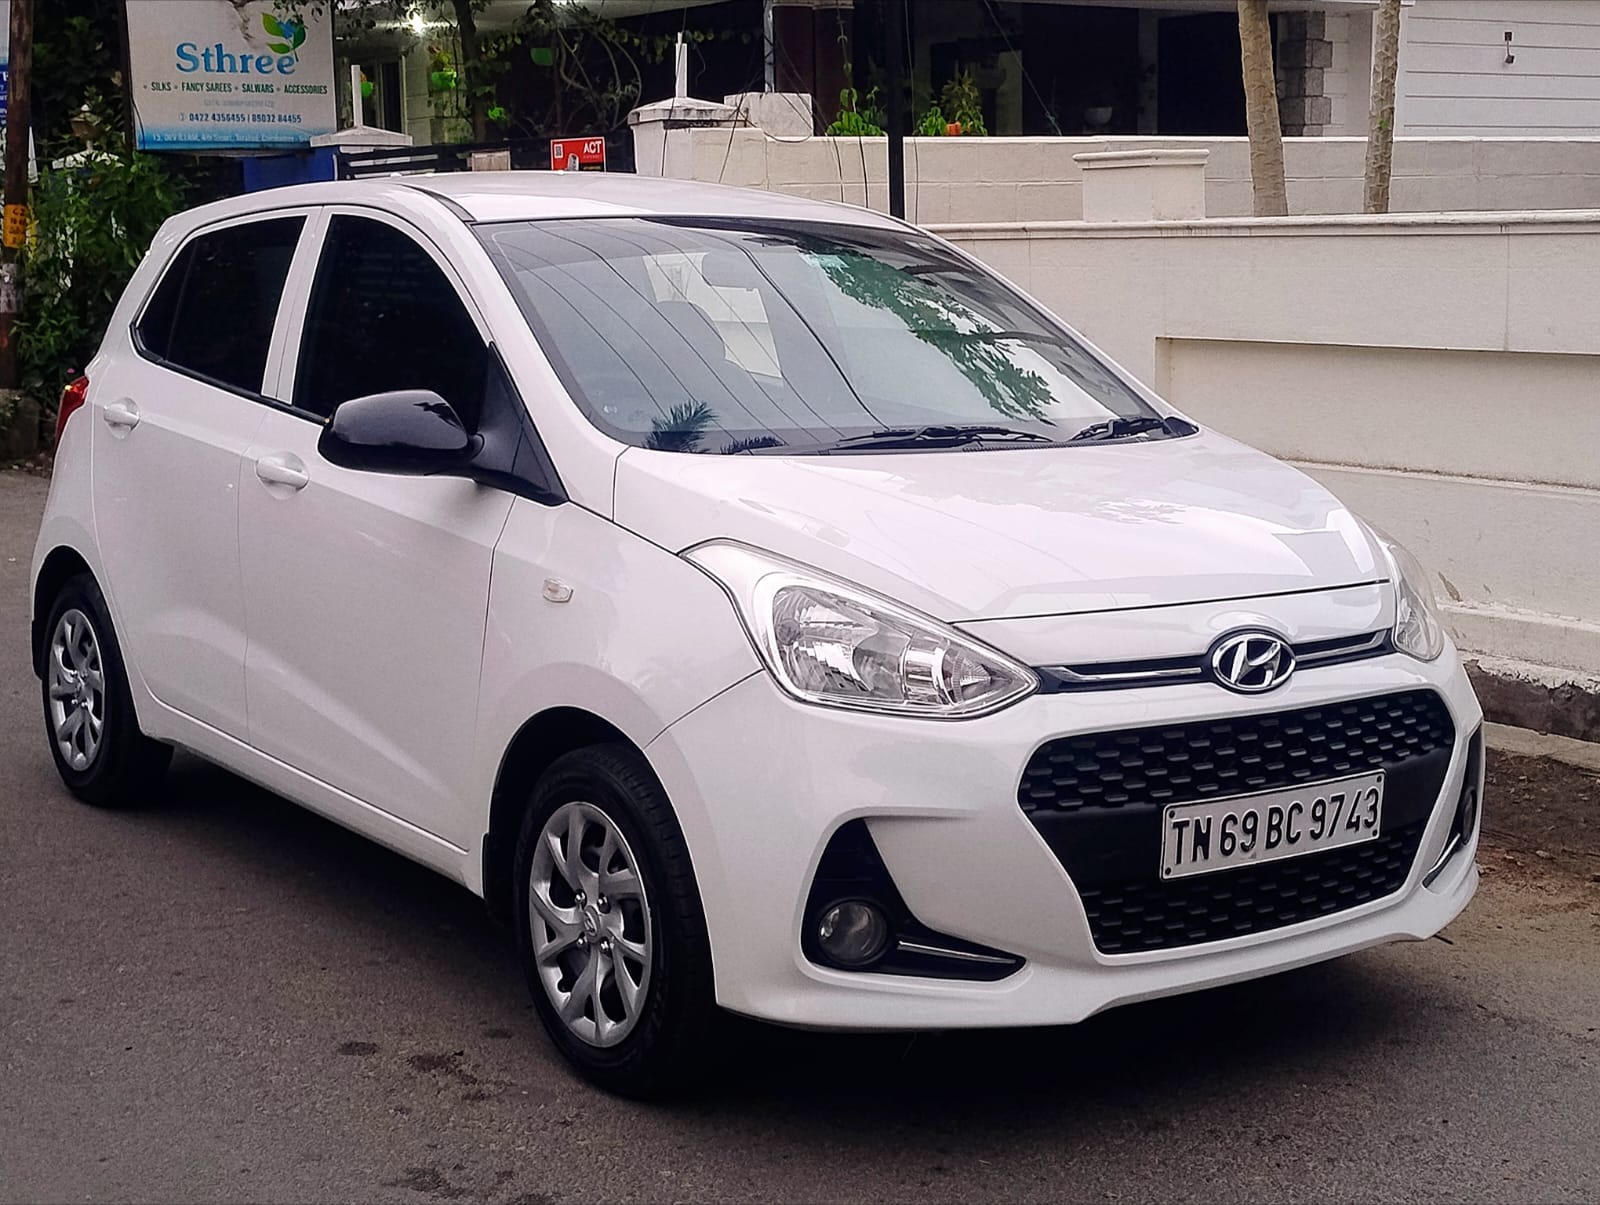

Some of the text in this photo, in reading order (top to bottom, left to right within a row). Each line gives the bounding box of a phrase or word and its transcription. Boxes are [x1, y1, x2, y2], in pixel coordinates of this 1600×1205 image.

[175, 42, 297, 75] Sthree
[151, 82, 328, 95] SILKS FANCY SAREES SALWARS ACCESSORIES
[583, 140, 602, 154] ACT
[1172, 786, 1380, 865] TN 69 BC 9743
